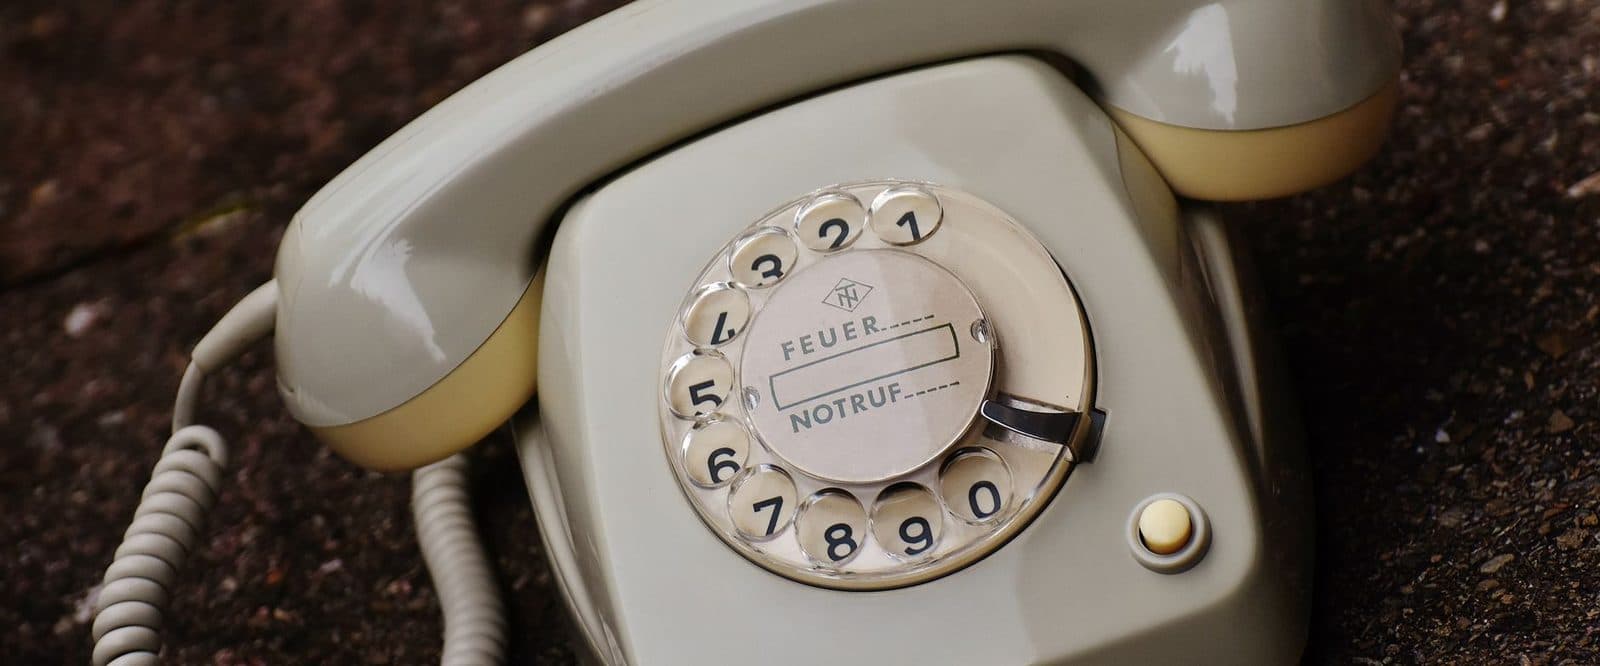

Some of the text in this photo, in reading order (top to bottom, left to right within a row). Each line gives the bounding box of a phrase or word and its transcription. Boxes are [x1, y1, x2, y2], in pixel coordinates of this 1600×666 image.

[818, 218, 849, 249] 2
[896, 211, 921, 241] 1
[751, 254, 784, 286] 3
[710, 311, 736, 345] 4
[781, 315, 880, 361] FEUER
[688, 379, 723, 416] 5
[789, 382, 902, 433] NOTRUF
[707, 447, 741, 484] 6
[752, 496, 784, 536] 7
[968, 480, 1002, 519] 0
[823, 523, 858, 562] 8
[898, 516, 934, 556] 9
